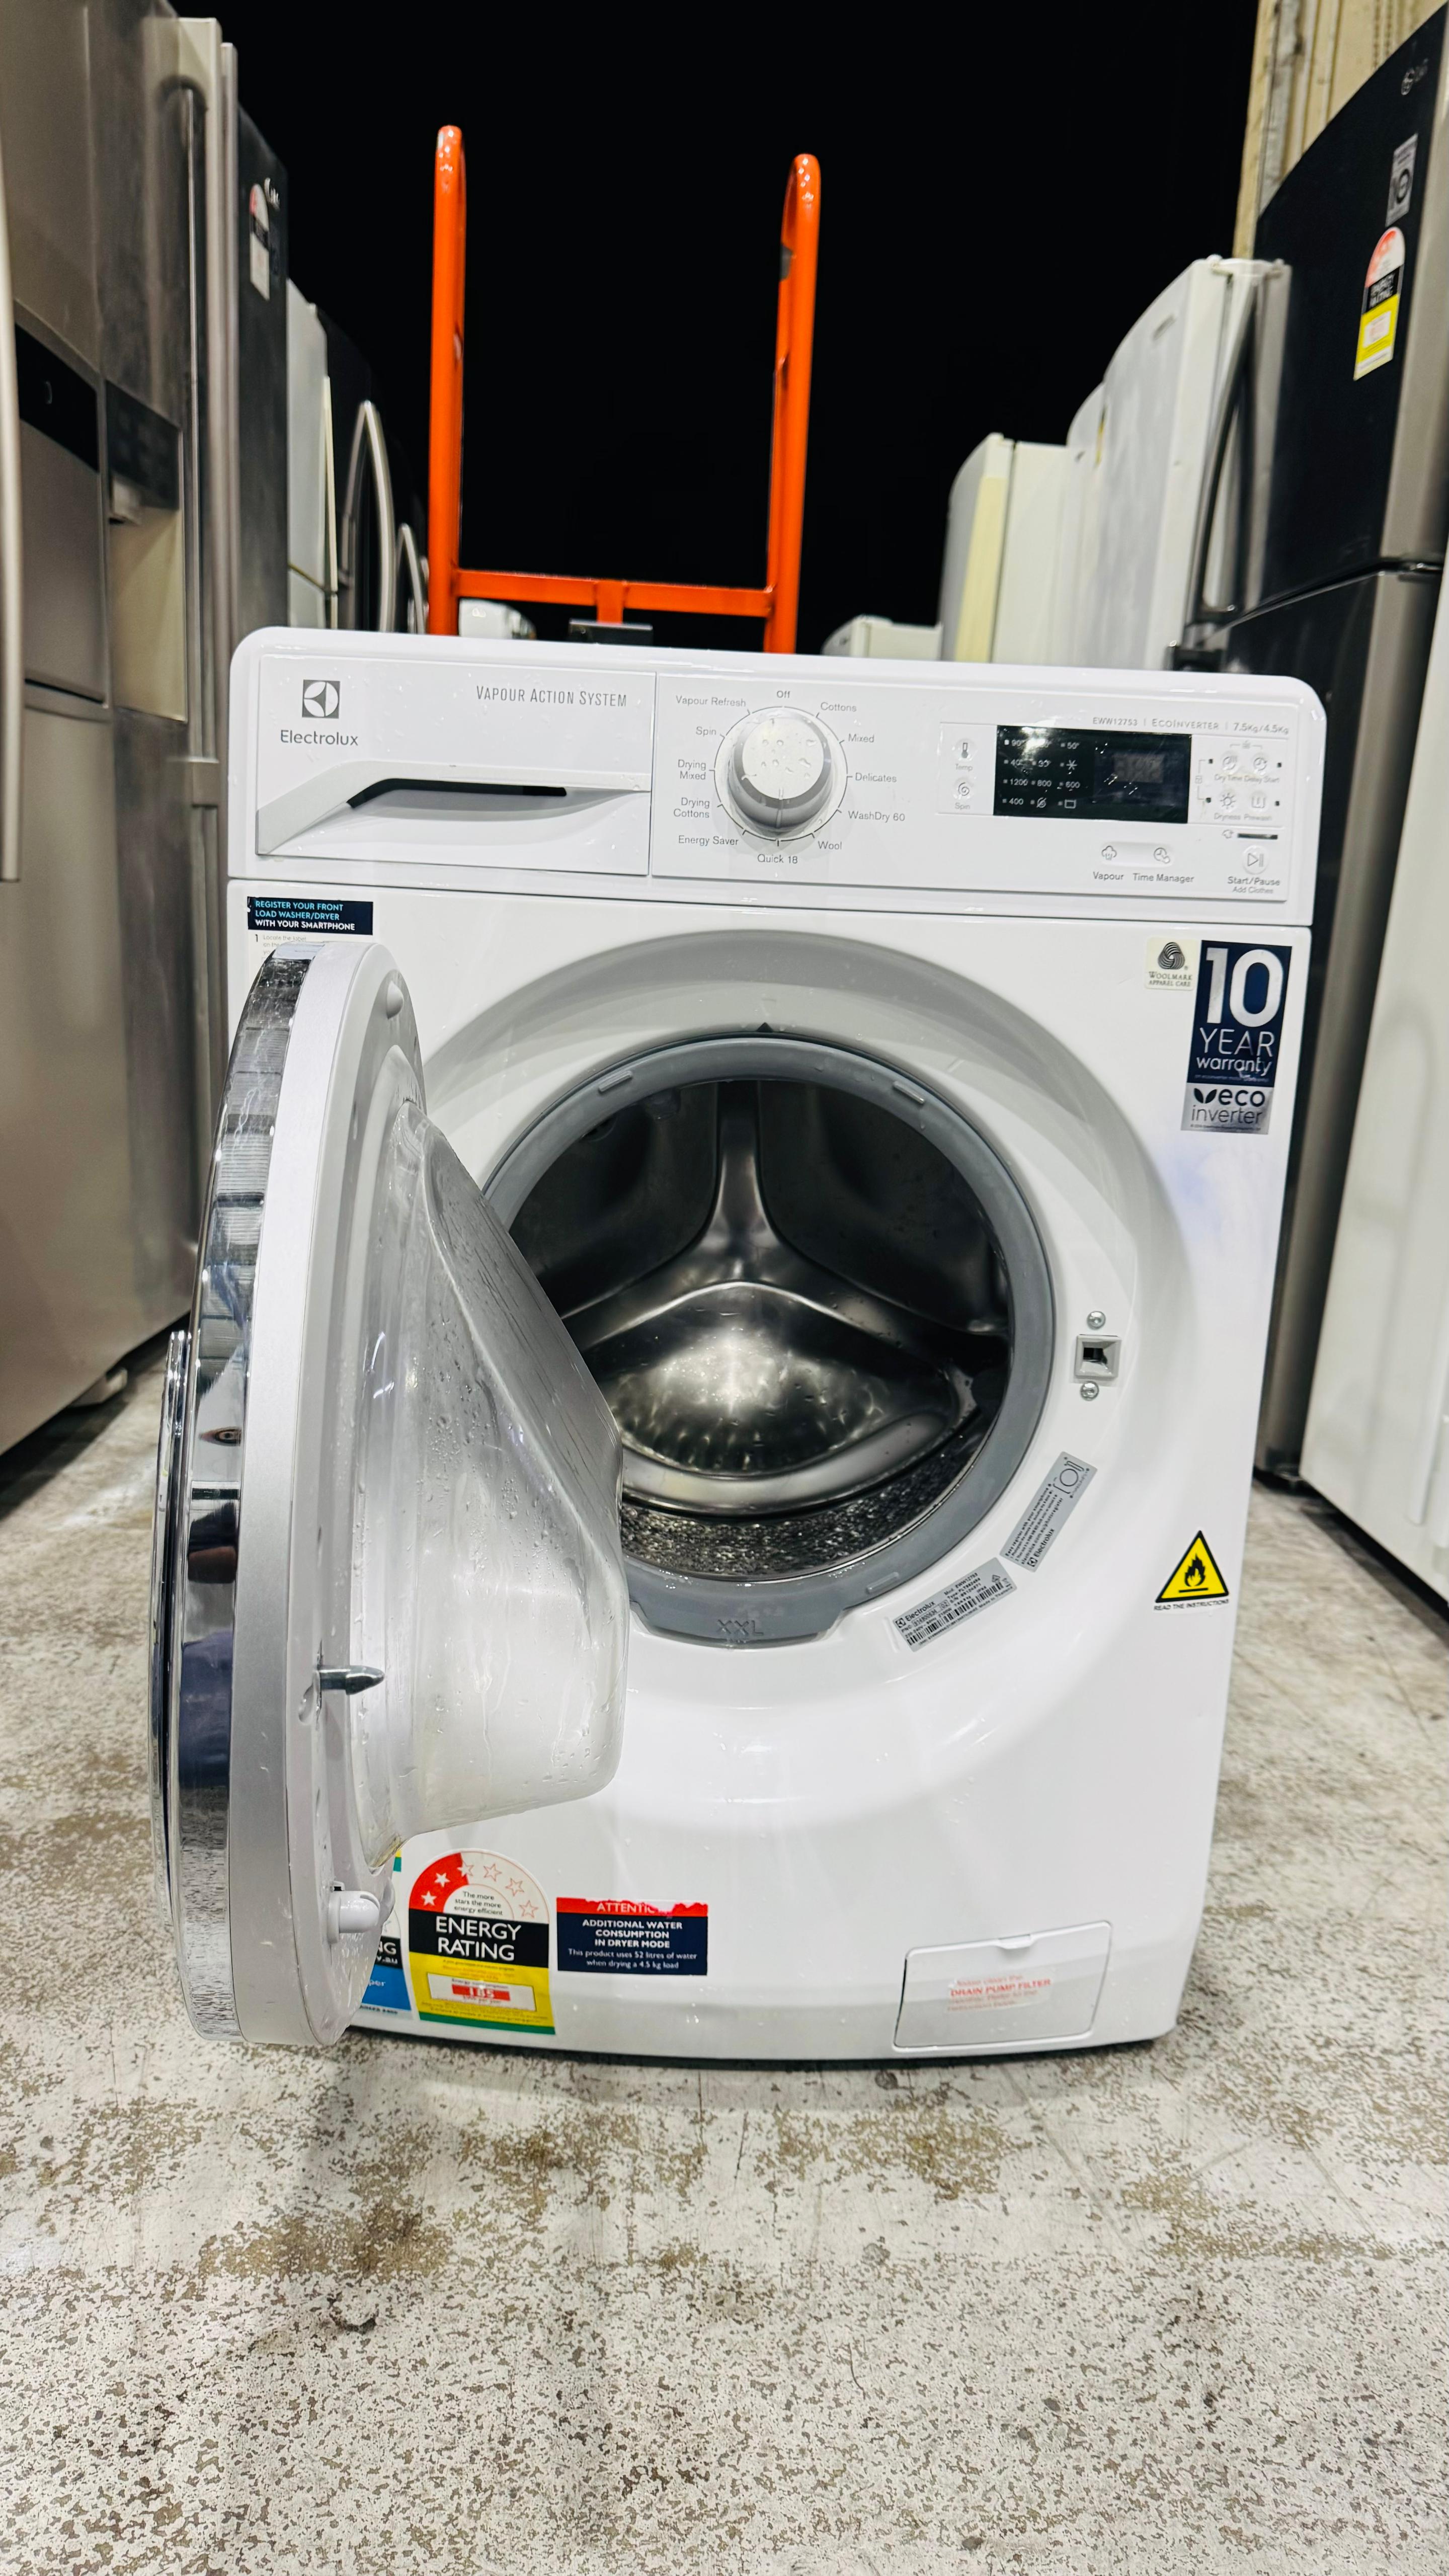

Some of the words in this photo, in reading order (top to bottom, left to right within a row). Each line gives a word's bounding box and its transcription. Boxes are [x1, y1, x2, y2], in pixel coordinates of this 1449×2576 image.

[476, 686, 525, 701] VAPOUR
[530, 689, 574, 704] ACTION
[579, 691, 627, 707] SYSTEM
[776, 690, 790, 698] Off
[676, 695, 708, 706] Vapour
[711, 697, 746, 706] Refresh
[820, 702, 857, 712] Cottons
[1092, 717, 1138, 727] EWW12753
[696, 726, 716, 737] Spin
[281, 730, 358, 746] Electrolux
[848, 734, 875, 744] Mixed
[678, 759, 706, 771] Drying
[955, 764, 973, 772] Temp
[680, 771, 706, 780] Mixed
[855, 773, 897, 783] Delicates
[681, 797, 710, 809] Drying
[673, 809, 709, 818] Cottons
[848, 811, 890, 823] WashDry
[893, 813, 905, 822] 60
[679, 835, 710, 846] Energy
[713, 836, 739, 845] Saver
[818, 841, 842, 850] Wool
[757, 854, 784, 864] Quick
[788, 856, 798, 864] 18
[1093, 871, 1123, 881] Vapour
[1133, 873, 1154, 881] Time
[1156, 874, 1194, 883] Manager
[1228, 876, 1280, 886] Start/Pause
[255, 901, 291, 909] REGISTER
[293, 902, 314, 910] YOUR
[317, 903, 343, 911] FRONT
[278, 911, 340, 920] WASHER/DRYER
[277, 920, 299, 928] YOUR
[301, 922, 355, 930] SMARTPHONE
[255, 934, 258, 942] 1
[1149, 972, 1192, 980] WOOLMARK
[1206, 947, 1284, 1027] 10
[1200, 1028, 1274, 1057] YEAR
[1196, 1057, 1272, 1076] warranty
[1219, 1089, 1265, 1107] eco
[1191, 1105, 1262, 1123] inverter
[1034, 1527, 1054, 1557] Electrolux
[905, 1600, 935, 1621] Electrolux
[717, 1619, 764, 1635] XXL
[436, 1915, 522, 1941] ENERGY
[583, 1919, 644, 1928] ADDITIONAL
[647, 1921, 682, 1929] WATER
[596, 1929, 669, 1938] CONSUMPTION
[438, 1937, 515, 1961] RATING
[608, 1940, 639, 1948] DRYER
[585, 1949, 614, 1958] product
[608, 1960, 630, 1969] drying
[653, 1961, 661, 1970] kg
[950, 1987, 982, 1996] DRAIN
[985, 1983, 1015, 1994] PUMP
[1018, 1979, 1051, 1989] FILTER
